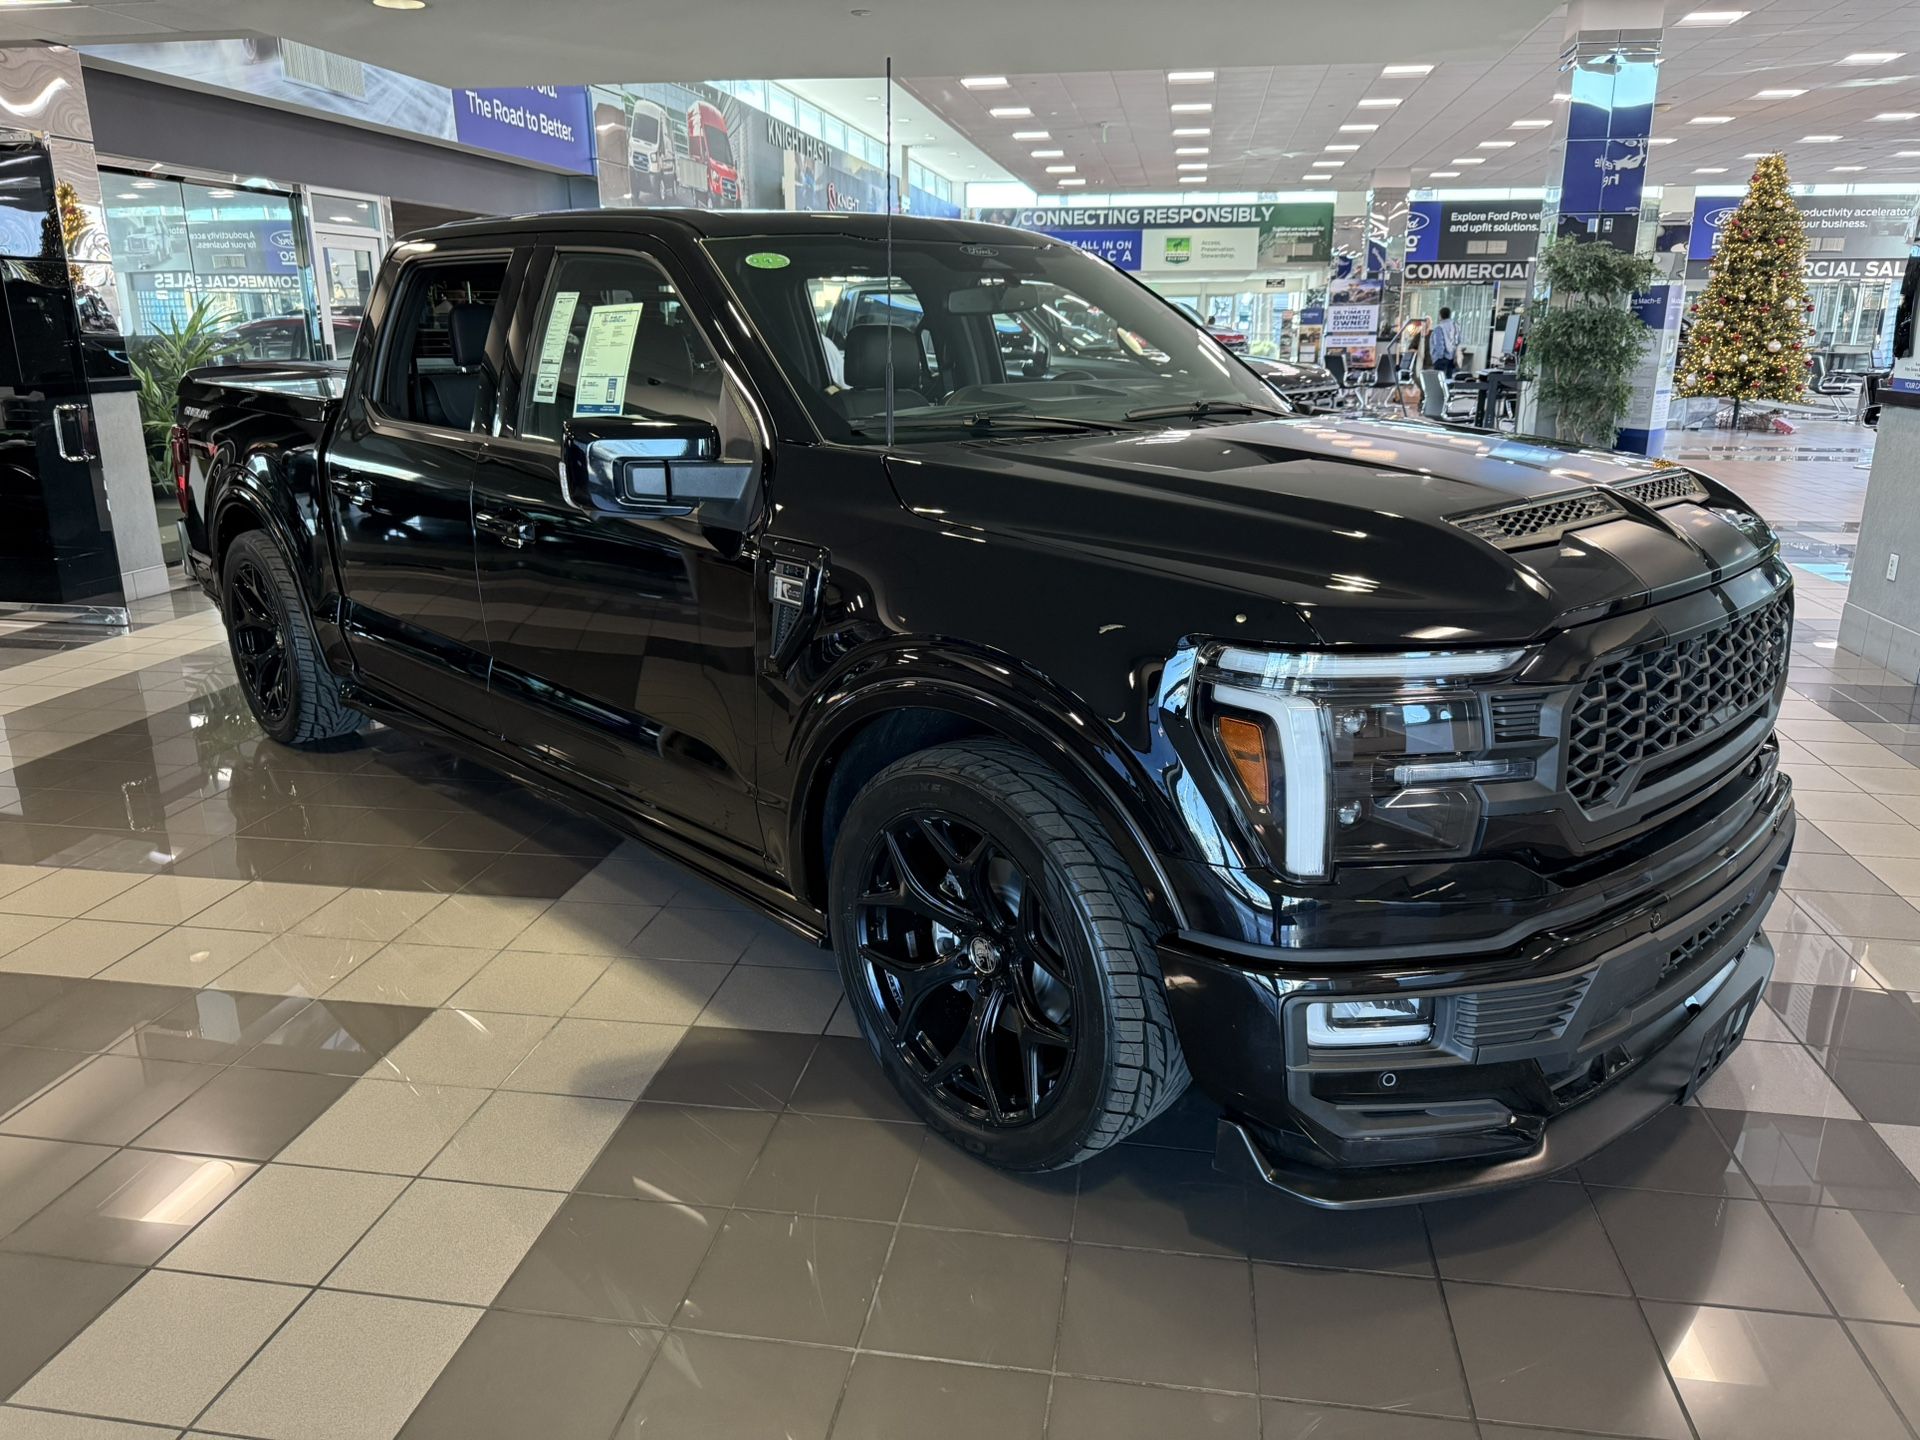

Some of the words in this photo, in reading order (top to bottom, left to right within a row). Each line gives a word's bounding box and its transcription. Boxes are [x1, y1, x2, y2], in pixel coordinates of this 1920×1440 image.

[465, 90, 491, 118] The
[494, 99, 524, 128] Road
[526, 110, 538, 130] to
[540, 113, 574, 142] Better.
[767, 118, 805, 153] KNIGHT
[806, 137, 823, 162] HAS
[823, 145, 833, 166] IT
[1020, 208, 1140, 226] CONNECTING
[1143, 206, 1275, 225] RESPONSIBLY
[1451, 211, 1486, 222] Explore
[1488, 211, 1509, 221] Ford
[1511, 211, 1526, 221] Pro
[1854, 207, 1911, 217] accelerator
[1449, 223, 1469, 233] and
[1470, 223, 1492, 234] upfit
[1493, 222, 1539, 232] solutions.
[1821, 219, 1868, 228] business.
[1081, 240, 1099, 250] ALL
[1103, 240, 1113, 250] IN
[1116, 240, 1132, 250] ON
